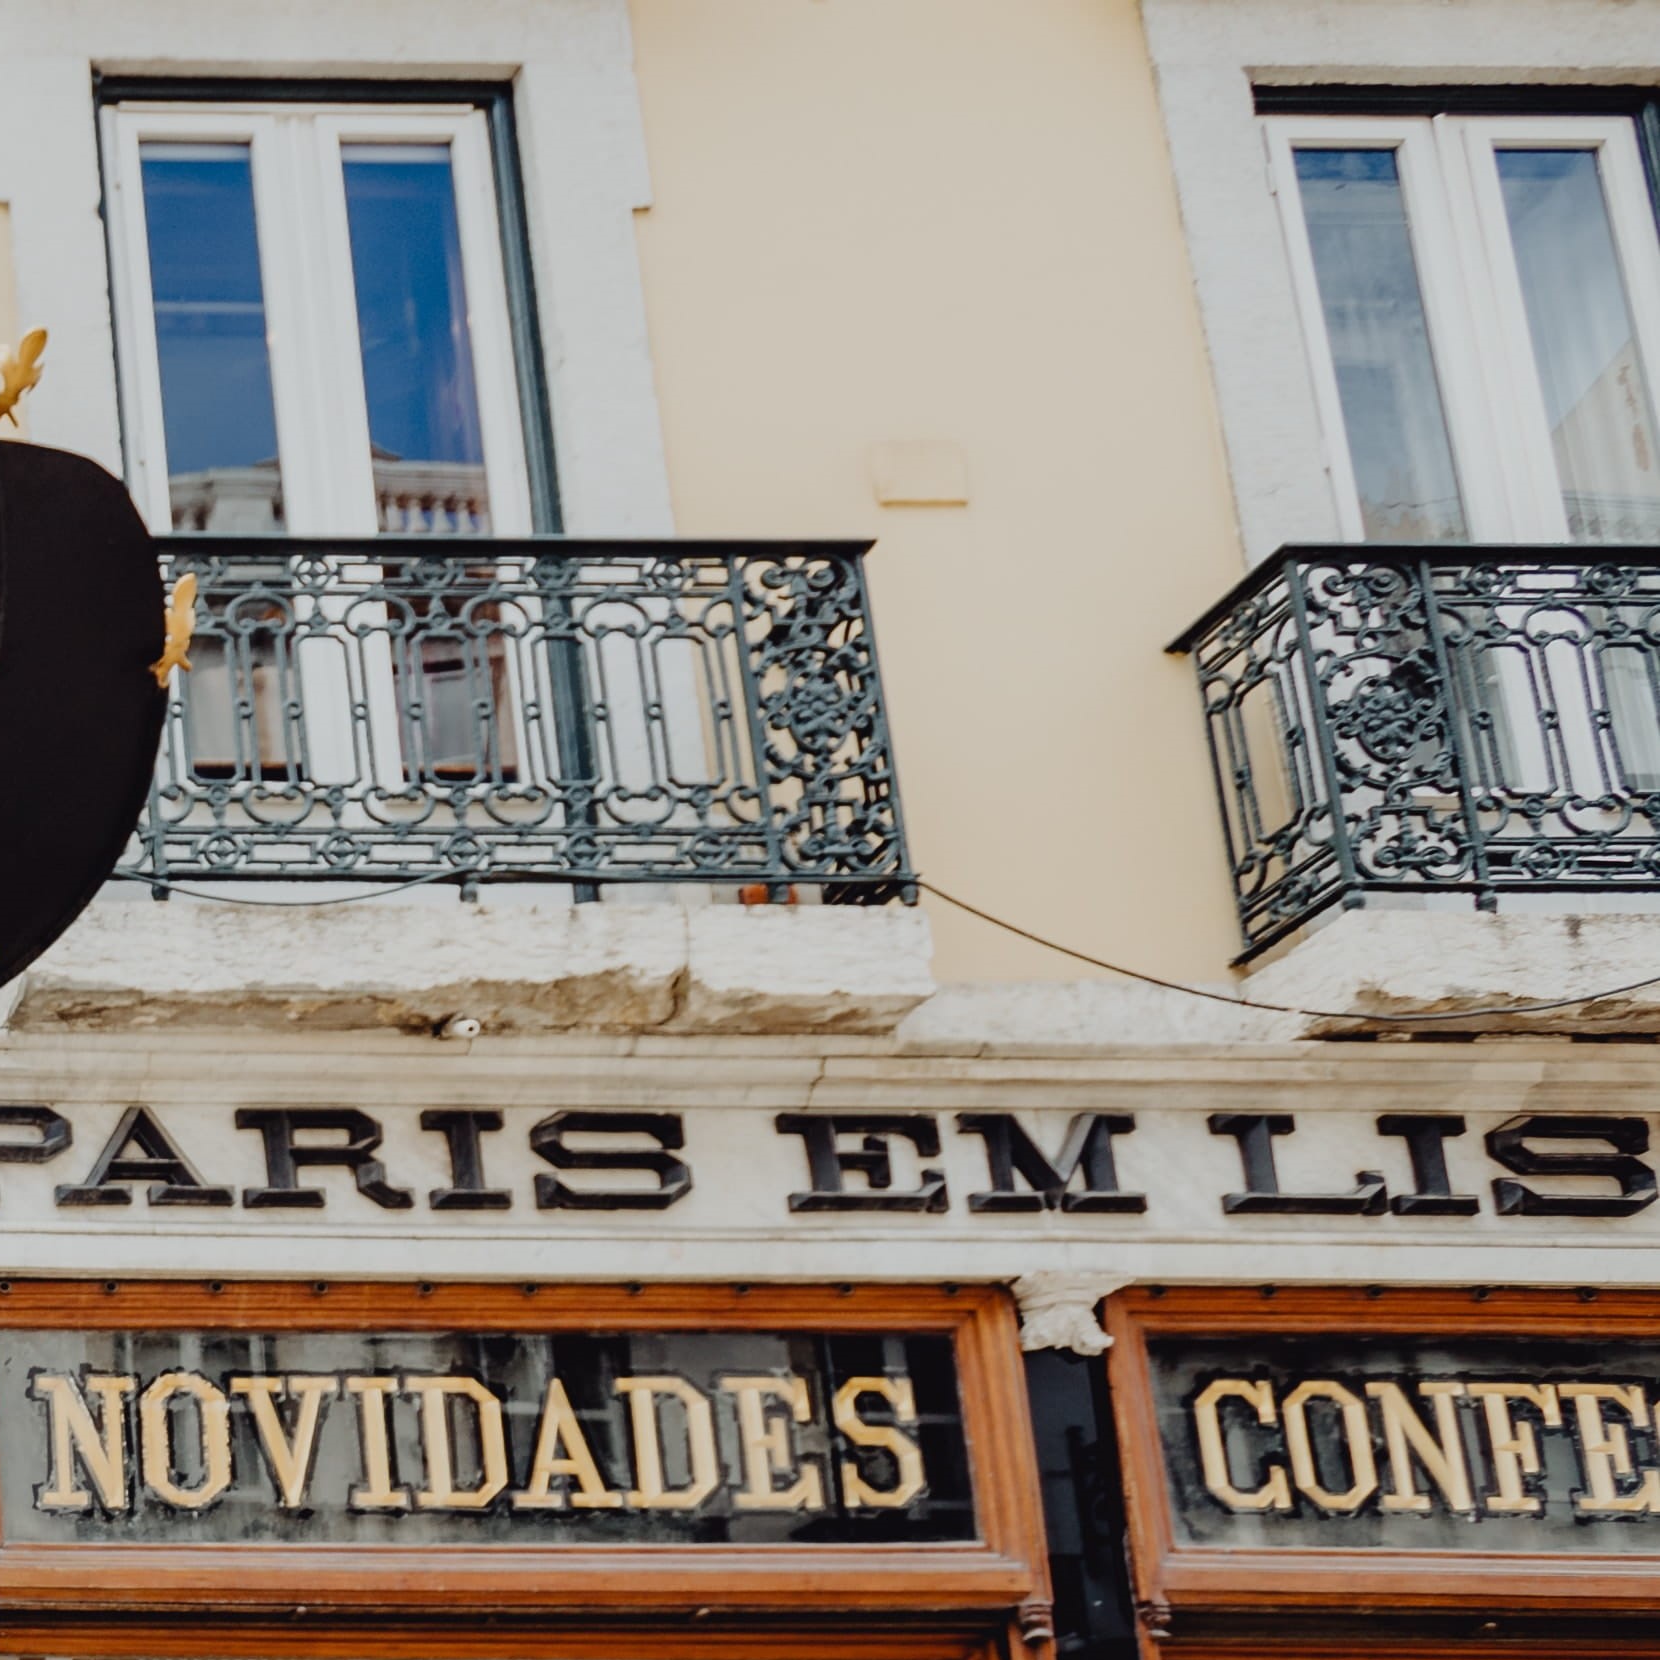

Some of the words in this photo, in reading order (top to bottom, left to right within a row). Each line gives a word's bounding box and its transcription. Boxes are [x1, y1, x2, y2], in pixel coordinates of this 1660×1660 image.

[774, 1112, 1150, 1216] EM
[32, 1371, 927, 1513] NOVIDADES
[1194, 1378, 1660, 1514] CONFE
